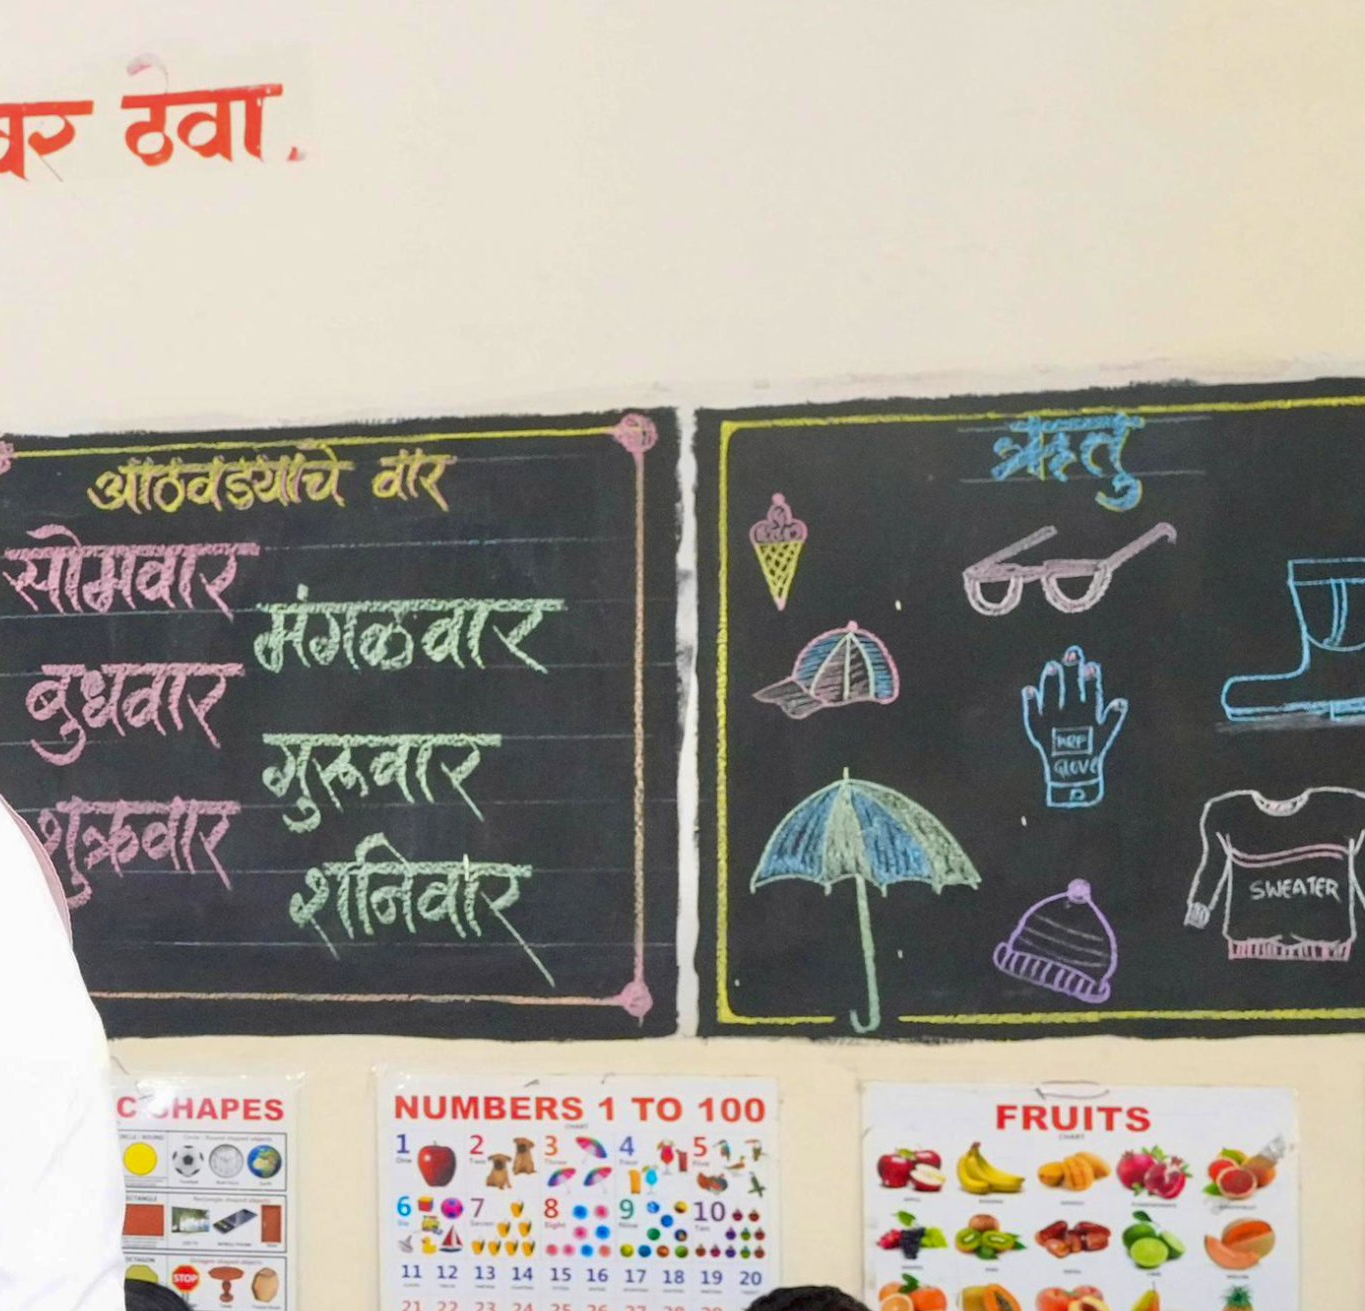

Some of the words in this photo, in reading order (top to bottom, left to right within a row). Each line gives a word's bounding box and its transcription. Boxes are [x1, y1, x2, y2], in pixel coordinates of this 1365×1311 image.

[372, 448, 457, 512] वार
[3, 524, 260, 621] सोमवार
[253, 584, 565, 675] मंगळवार
[26, 662, 245, 765] बुधवार
[36, 795, 242, 910] शुक्रवार
[290, 832, 555, 989] शनिवार
[1249, 877, 1340, 902] SWEATER
[394, 1095, 584, 1121] NUMBERS
[598, 1098, 614, 1120] 1
[632, 1097, 683, 1121] TO
[698, 1098, 766, 1122] 100
[996, 1105, 1152, 1132] FRUITS
[173, 1274, 197, 1282] STOP
[402, 1265, 422, 1279] 11
[437, 1265, 458, 1279] 12
[475, 1266, 496, 1280] 13
[512, 1267, 534, 1281] 14
[587, 1268, 609, 1282] 16
[739, 1271, 762, 1286] 20
